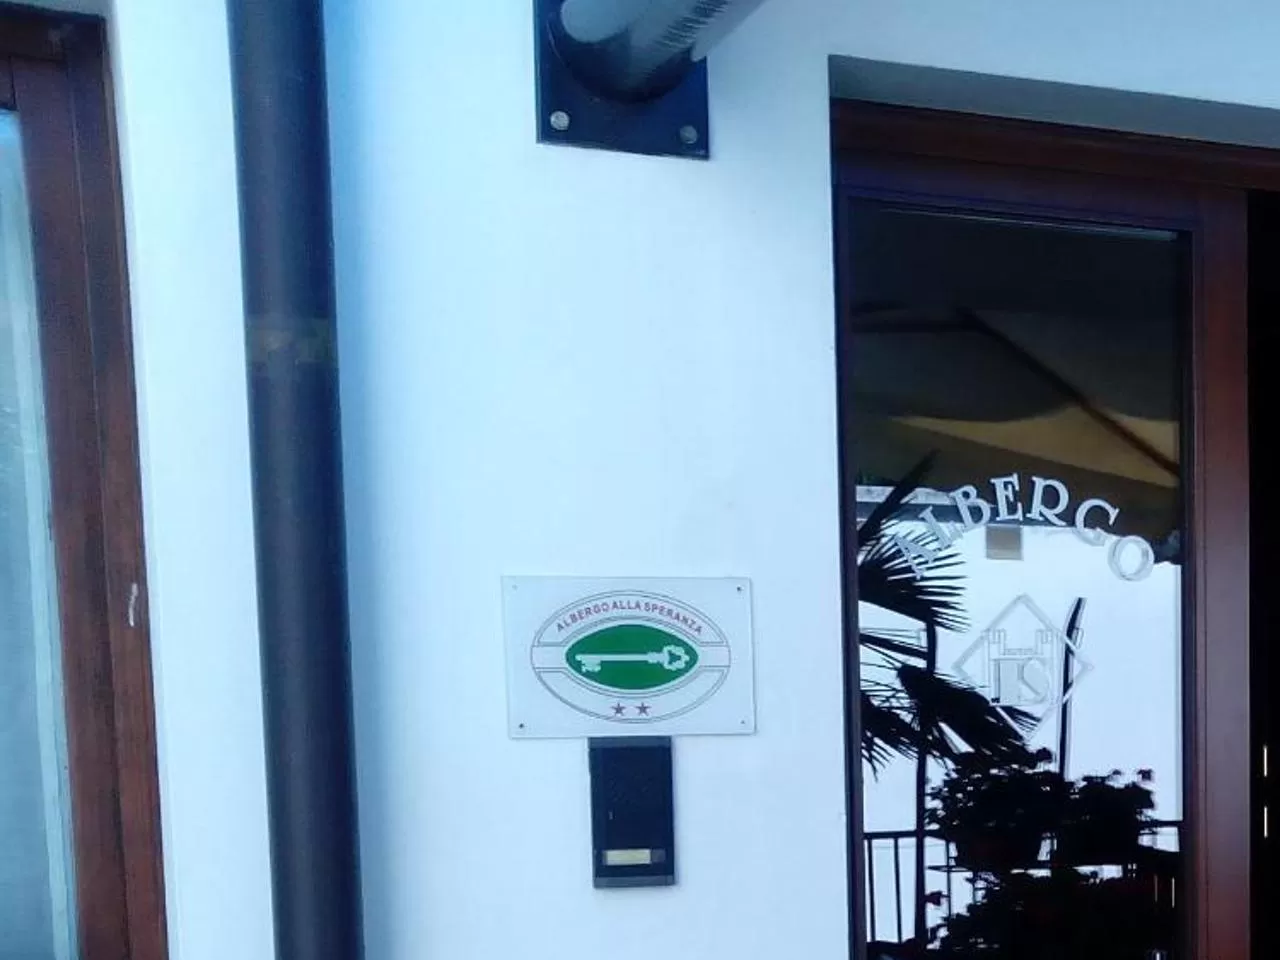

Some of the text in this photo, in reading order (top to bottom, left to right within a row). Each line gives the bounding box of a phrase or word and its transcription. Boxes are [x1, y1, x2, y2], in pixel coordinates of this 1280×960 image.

[893, 472, 1154, 581] ALBERGO
[556, 600, 703, 634] ALBERGO ALLA SPERANZA
